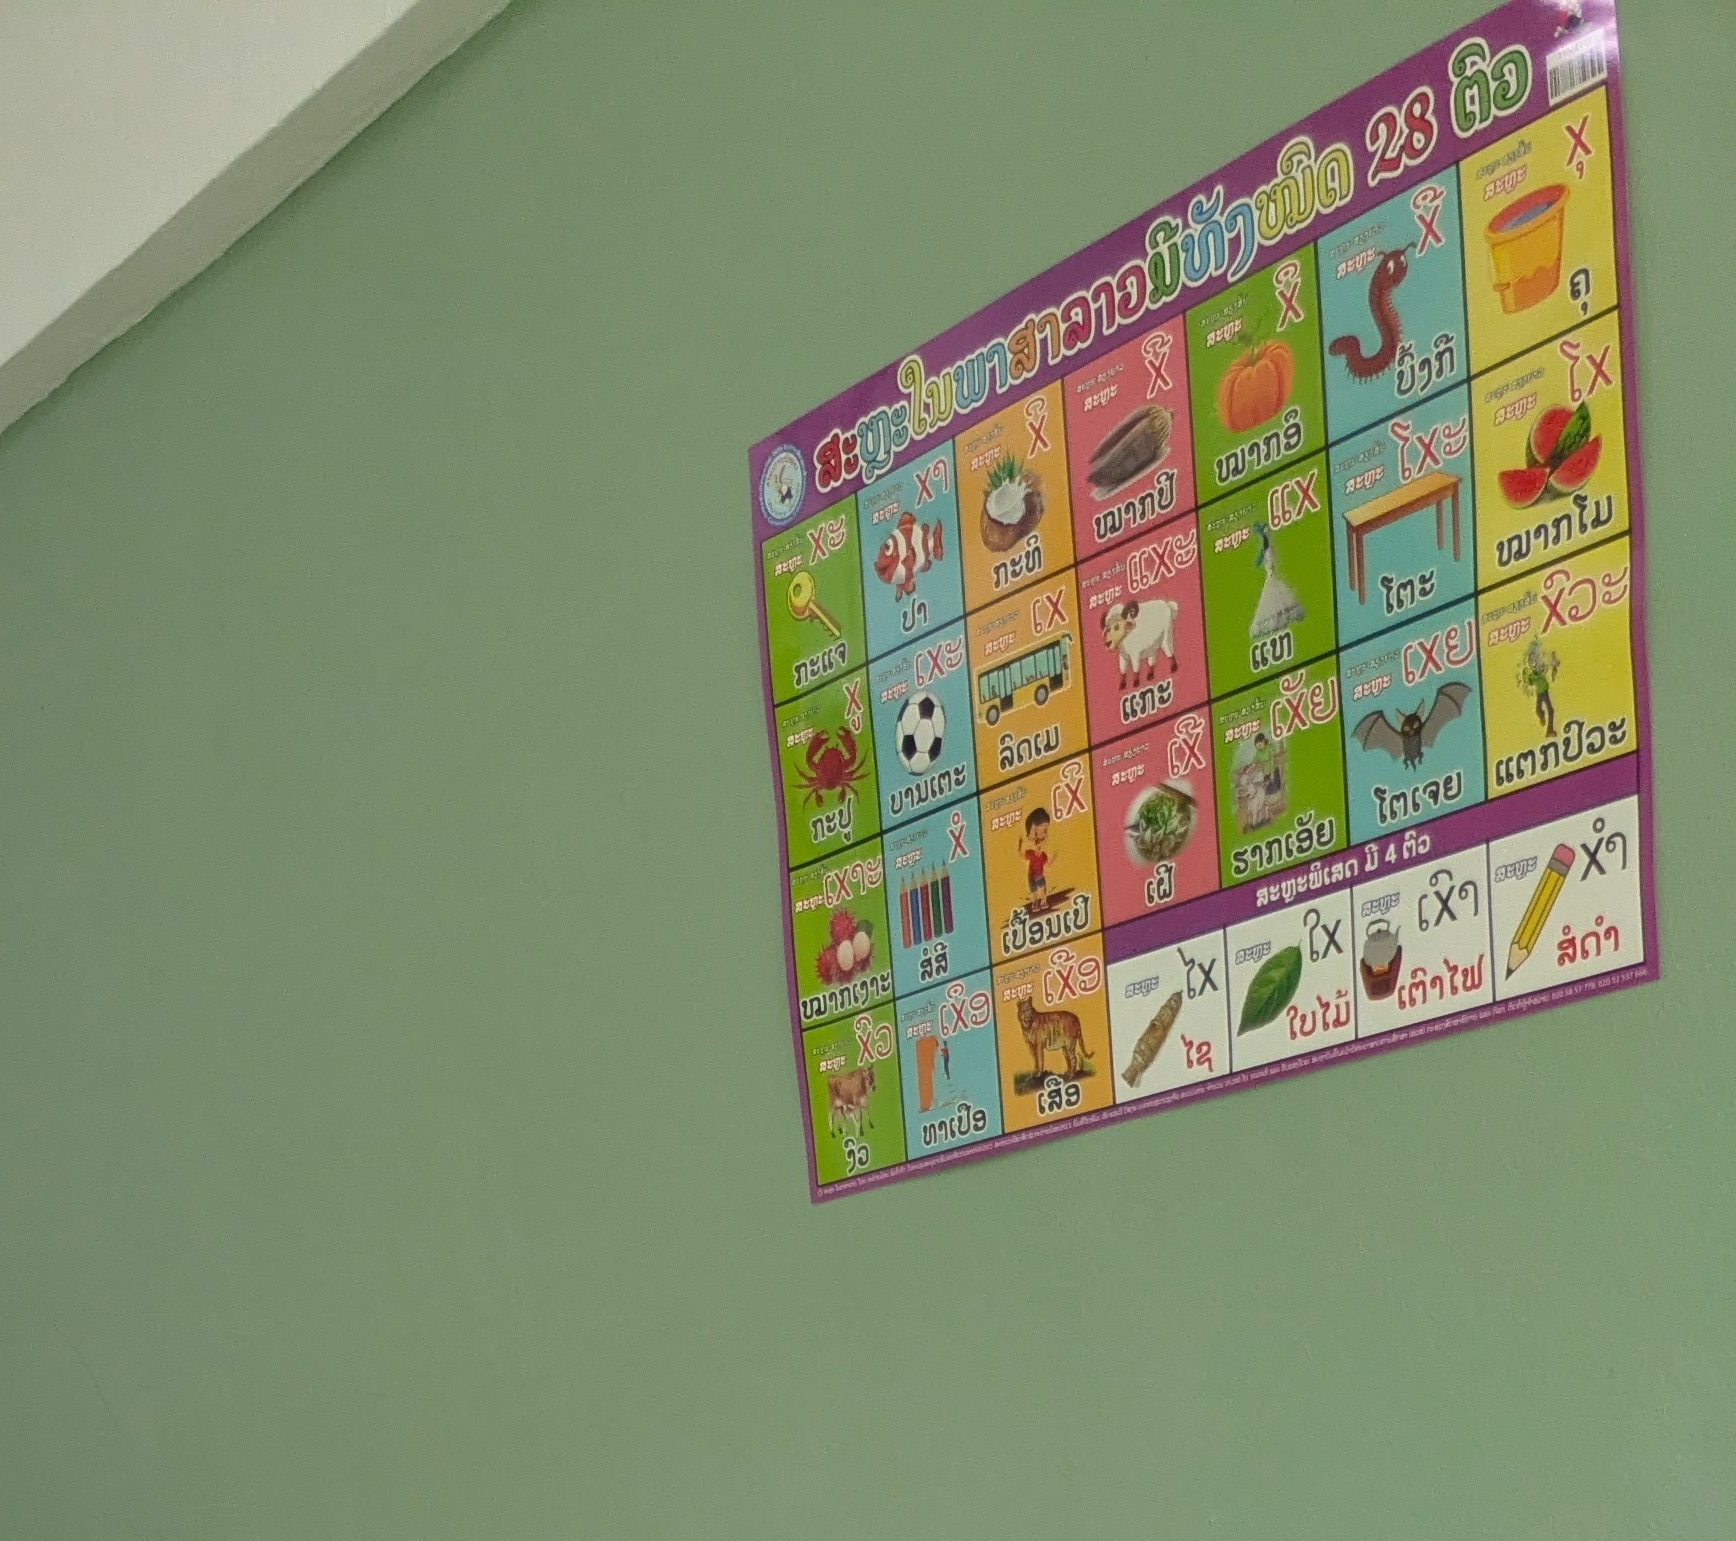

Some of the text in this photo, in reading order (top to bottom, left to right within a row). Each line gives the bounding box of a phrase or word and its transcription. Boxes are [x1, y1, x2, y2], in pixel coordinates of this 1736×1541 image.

[1367, 88, 1436, 186] 28
[1448, 38, 1531, 137] ຕົວ
[1568, 266, 1591, 316] ຄຸ
[1495, 492, 1614, 568] ໝາກໂມ
[992, 532, 1044, 590] ກະທິ
[901, 599, 929, 634] ປາ
[1379, 569, 1436, 616] ໂຕະ
[794, 641, 848, 688] ກະແຈ
[1249, 630, 1294, 672] ແຫ
[1119, 679, 1173, 724] ແກະ
[1494, 716, 1629, 788] ແຕກປົວະ
[889, 764, 967, 817] ບານເຕະ
[1372, 770, 1464, 826] ໂຕເຈຍ
[810, 796, 853, 844] ກະປູ
[1364, 841, 1379, 872] ມີ
[1384, 844, 1397, 864] 4
[1402, 832, 1431, 859] ຕົວ
[1556, 915, 1621, 968] ສໍດຳ
[800, 970, 892, 1022] ໝາກເງາະ
[1396, 953, 1486, 1011] ເຕົາໄຟ
[1285, 989, 1352, 1041] ໃບໄມ້
[1180, 1033, 1215, 1074] ໄຊ
[1037, 1075, 1082, 1116] ເສືອ
[843, 1136, 870, 1176] ງົວ
